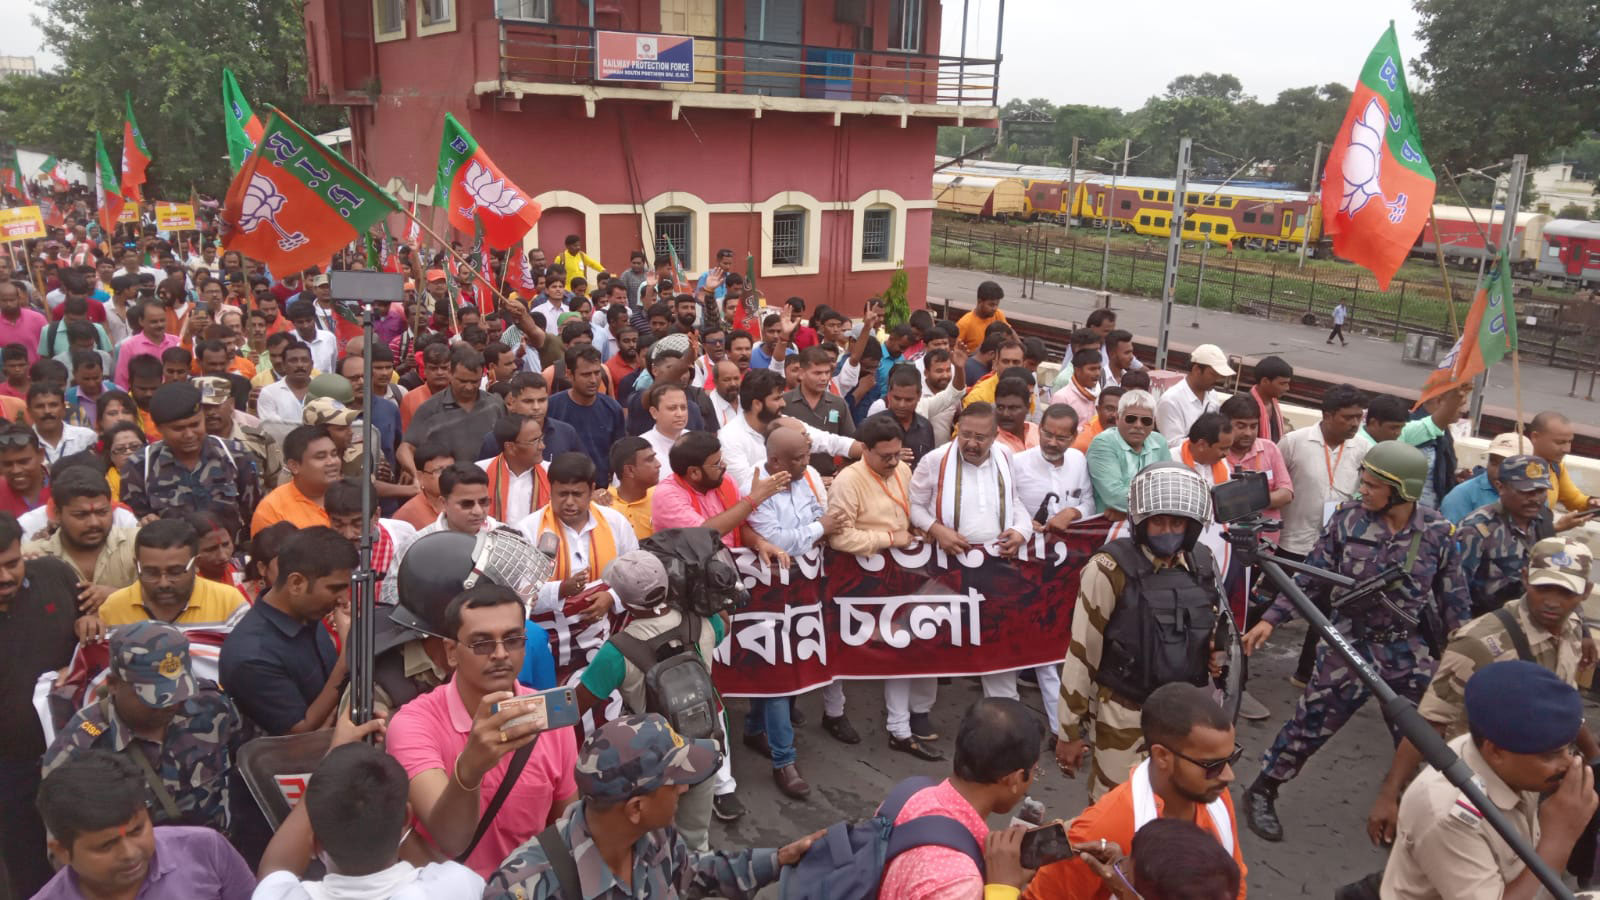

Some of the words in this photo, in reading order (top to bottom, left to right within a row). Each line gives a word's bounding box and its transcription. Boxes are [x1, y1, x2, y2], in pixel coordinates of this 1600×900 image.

[603, 59, 630, 69] RAILWAY
[632, 60, 670, 71] PROTECTION
[671, 62, 690, 72] FORCE
[832, 586, 987, 649] চলো
[80, 721, 102, 737] CISF
